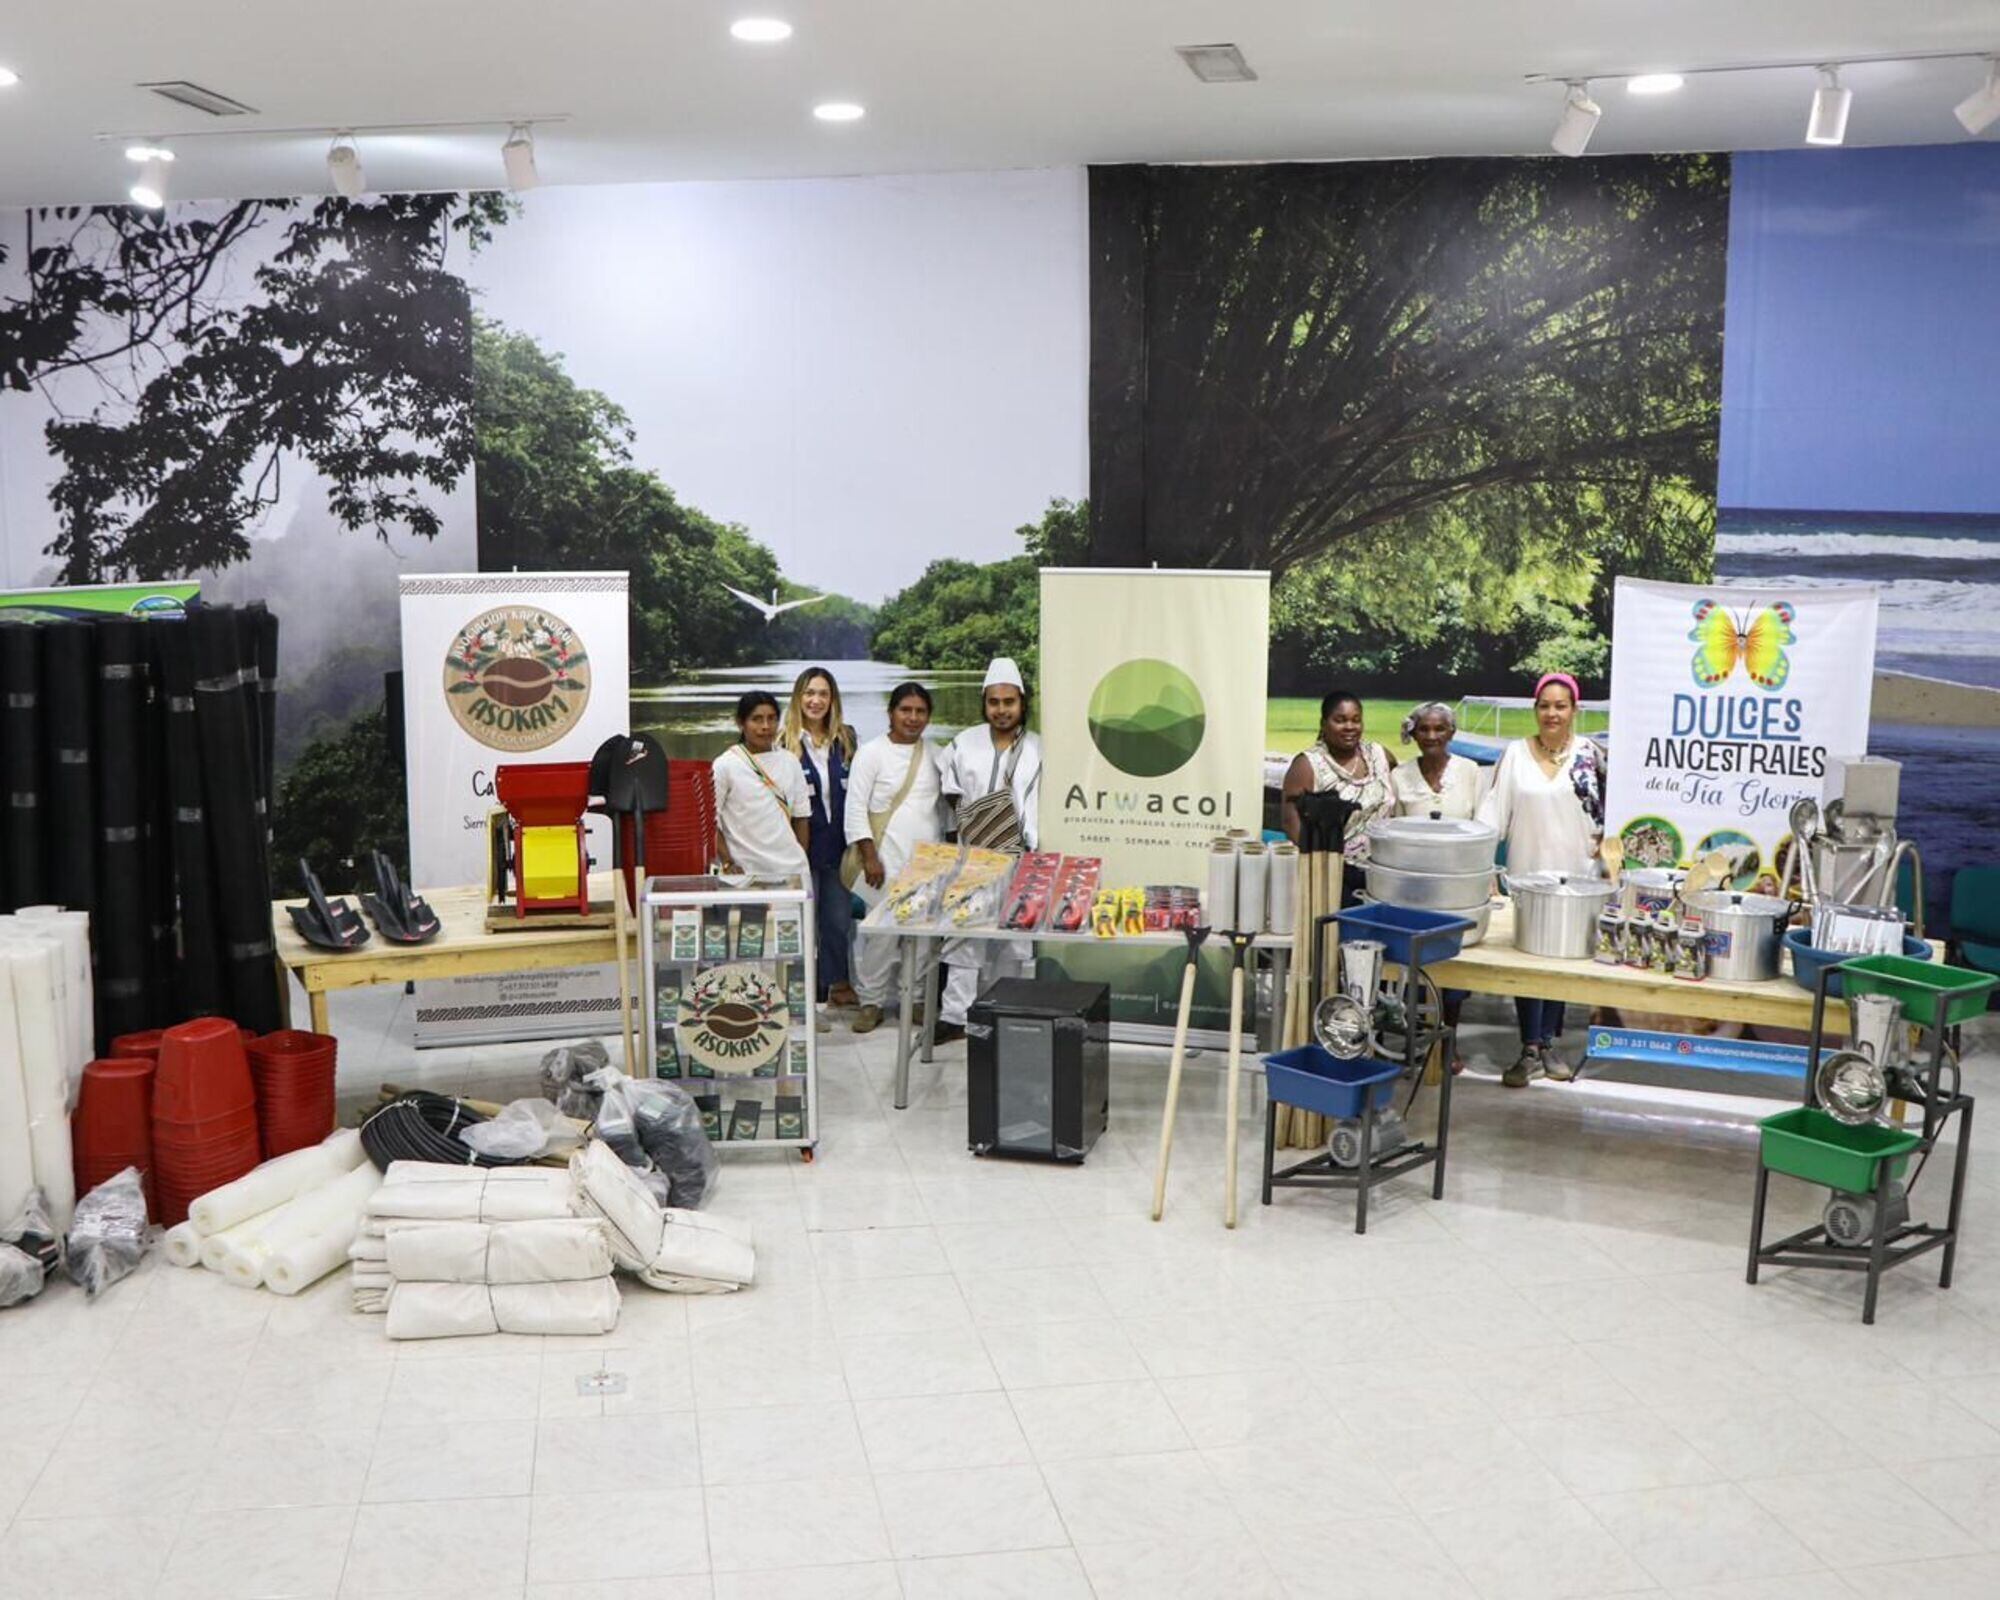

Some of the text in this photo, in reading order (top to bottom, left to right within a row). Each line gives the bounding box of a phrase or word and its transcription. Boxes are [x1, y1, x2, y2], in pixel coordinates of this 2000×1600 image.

[467, 694, 568, 732] ASOKAM
[1672, 693, 1802, 742] DULCES
[1644, 737, 1827, 778] ANCESTRALES
[472, 770, 495, 797] Ca
[1645, 777, 1662, 790] de
[1665, 778, 1680, 792] la
[1065, 783, 1232, 818] Arwacol
[1185, 840, 1211, 849] CREA
[693, 1029, 771, 1058] ASOKAM
